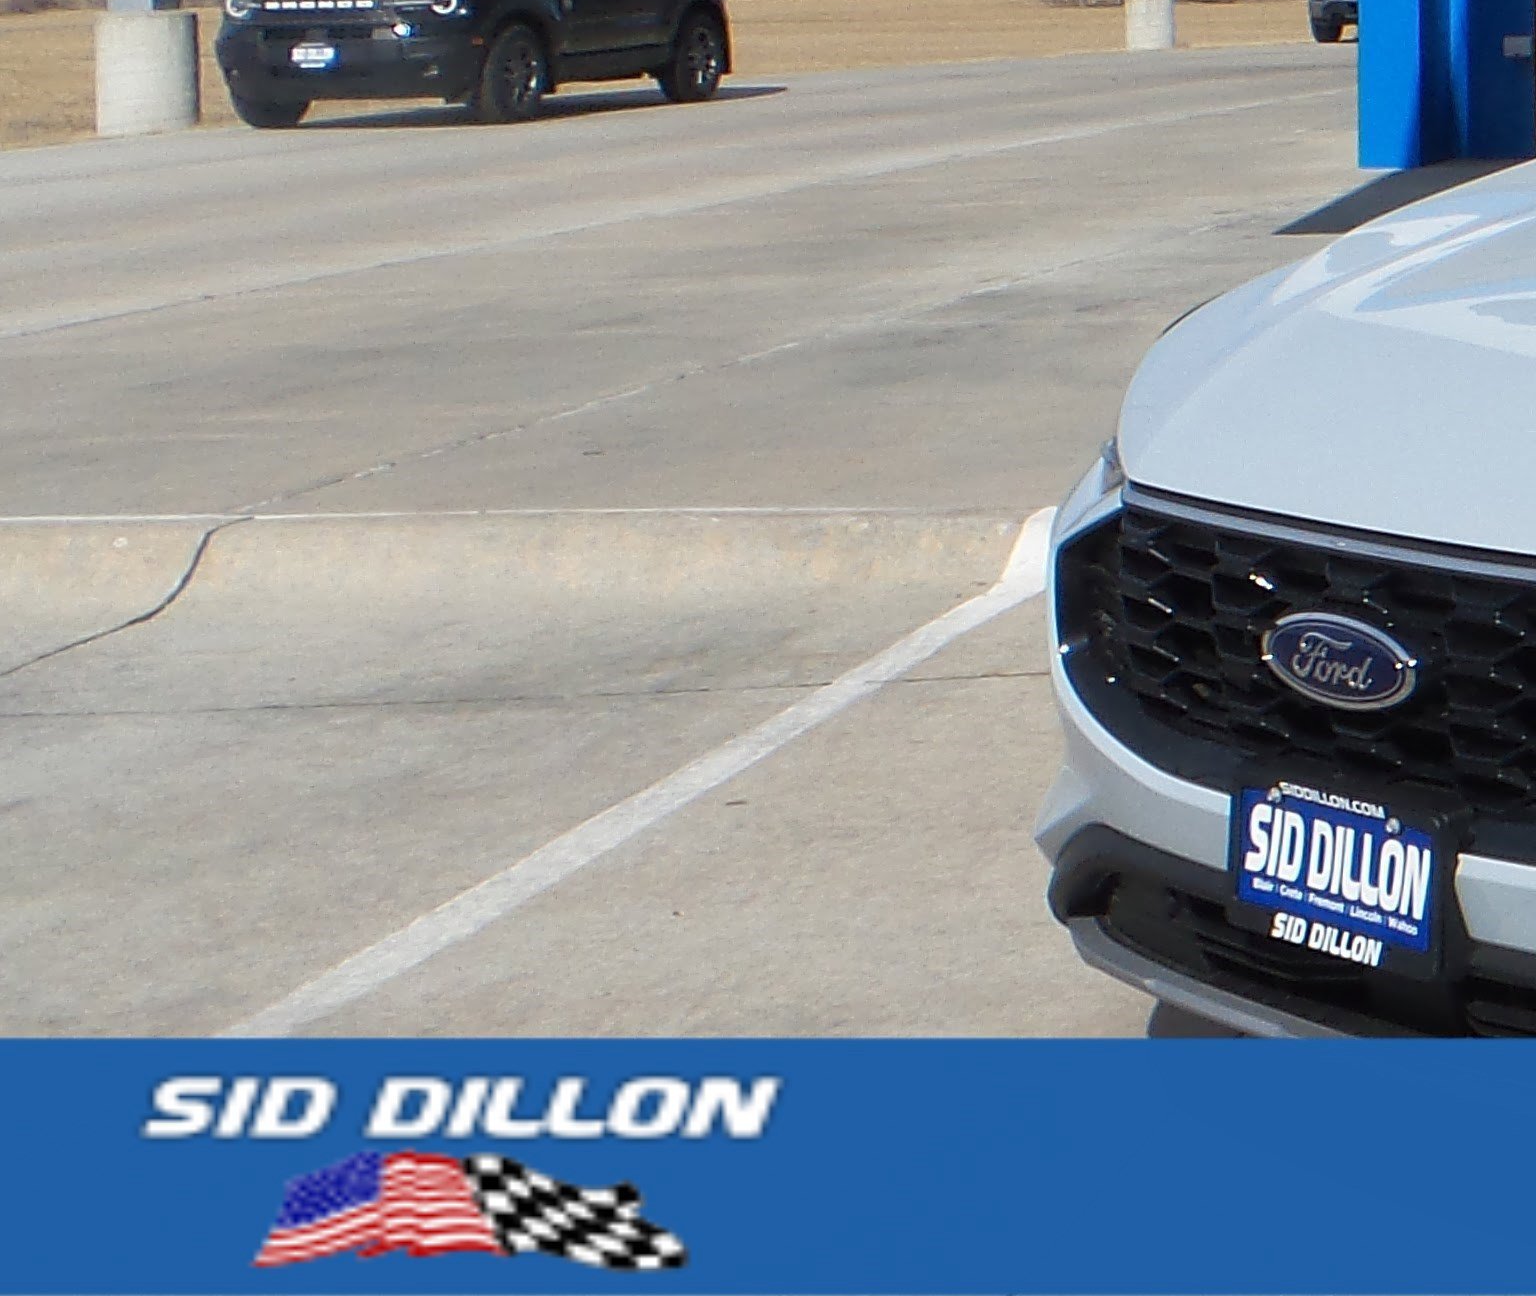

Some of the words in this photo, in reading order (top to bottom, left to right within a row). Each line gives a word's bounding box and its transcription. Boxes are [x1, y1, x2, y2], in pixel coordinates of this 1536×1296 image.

[1291, 631, 1374, 690] Ford
[1244, 803, 1305, 882] SID
[1306, 817, 1431, 921] DILLON
[1271, 911, 1307, 945] SID
[1308, 921, 1383, 967] DILLON
